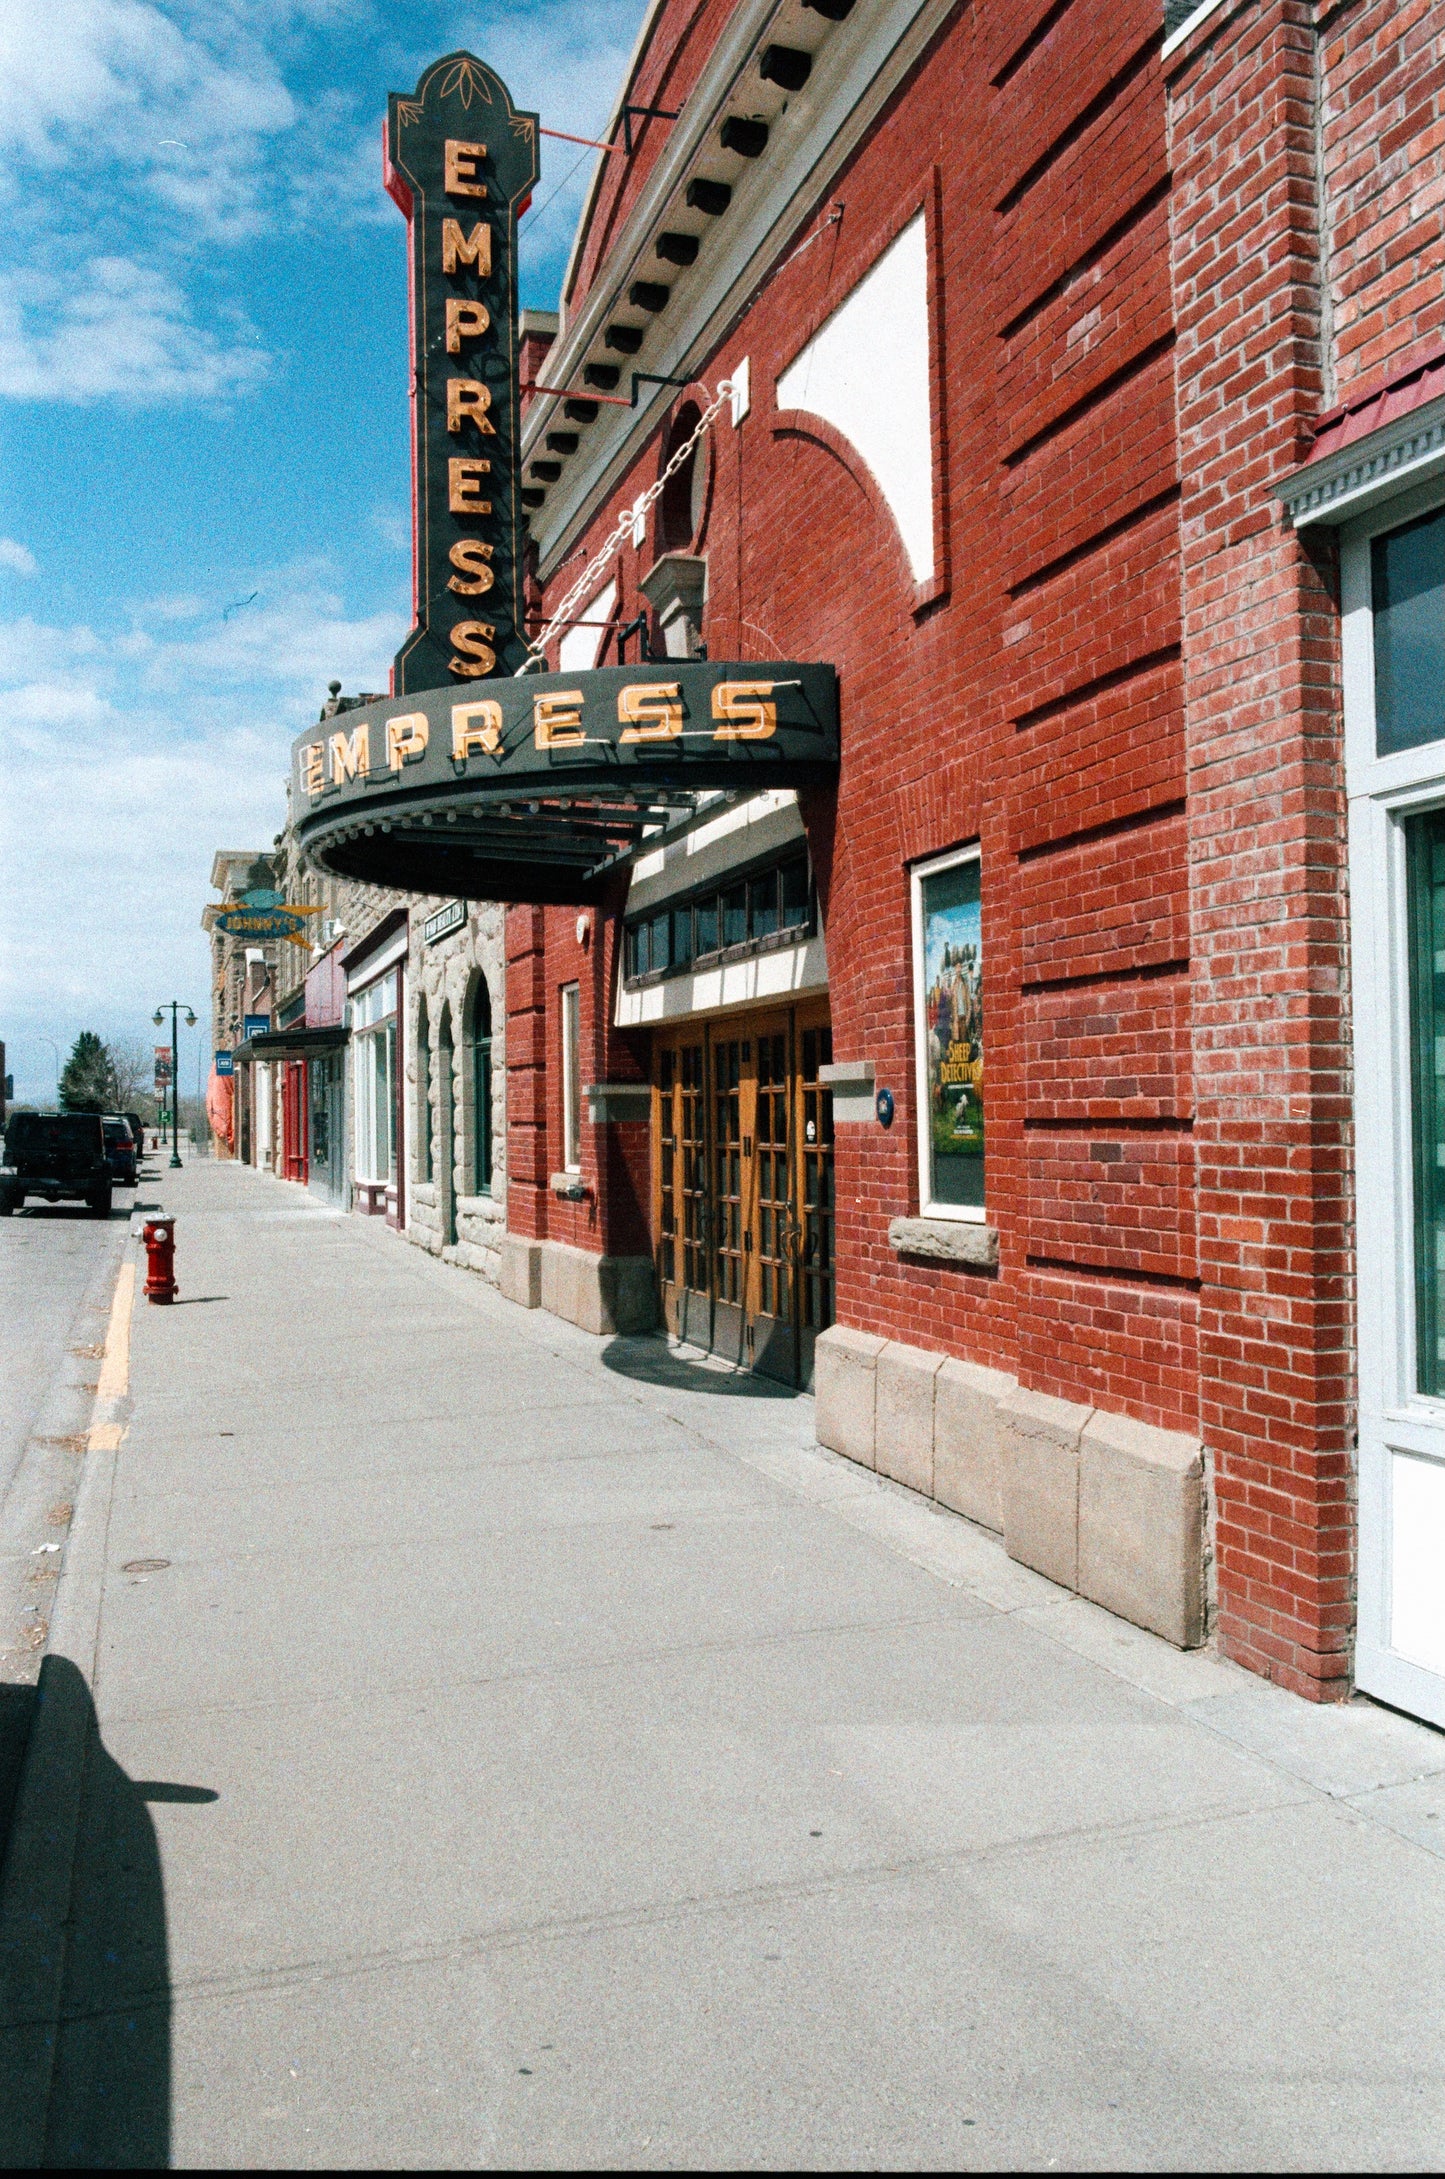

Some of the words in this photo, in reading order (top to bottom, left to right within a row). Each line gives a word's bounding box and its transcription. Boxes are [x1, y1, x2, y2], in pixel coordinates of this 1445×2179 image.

[442, 139, 496, 677] EMPRESS
[300, 680, 778, 794] EMPRESS
[226, 916, 297, 931] JOHNNY'S
[948, 1040, 971, 1062] SHEEP
[941, 1061, 983, 1083] DETECTIVES
[161, 1111, 168, 1119] P
